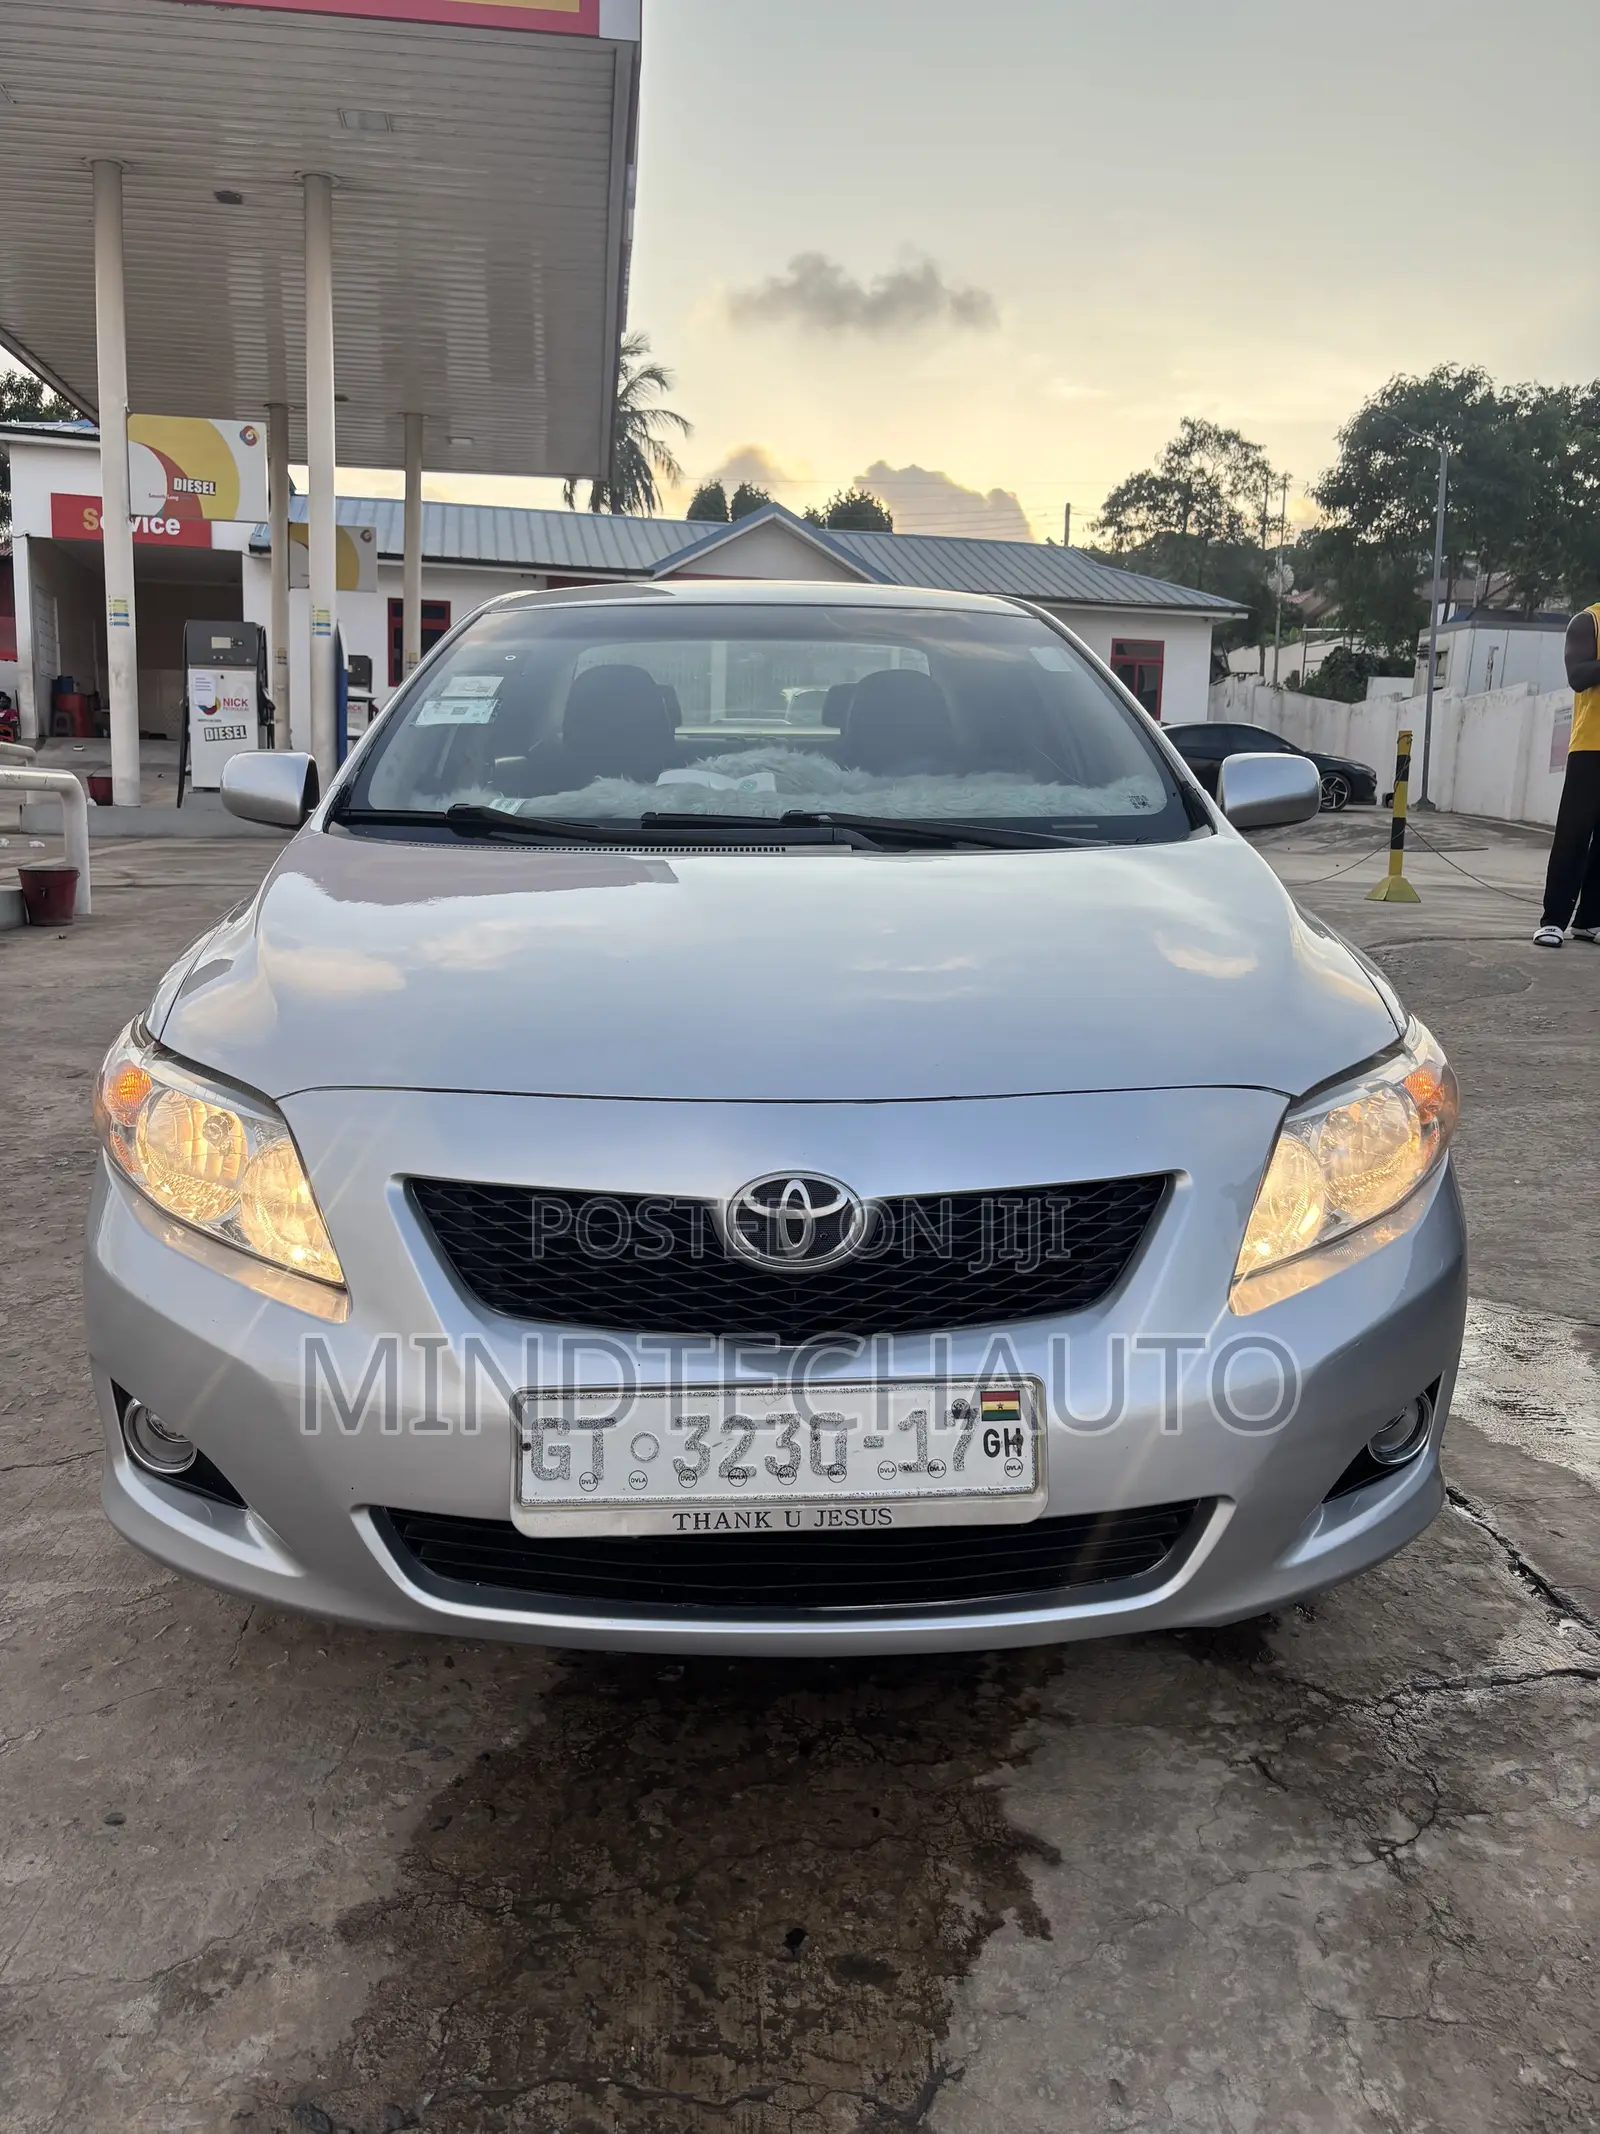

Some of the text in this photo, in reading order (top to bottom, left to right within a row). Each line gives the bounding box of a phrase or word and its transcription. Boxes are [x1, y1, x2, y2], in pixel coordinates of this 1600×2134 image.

[173, 477, 216, 495] DIESEL
[83, 507, 180, 536] Svice
[223, 698, 248, 707] NICK
[205, 727, 247, 740] DIESEL
[531, 1416, 617, 1480] GT
[983, 1428, 1023, 1458] GH
[929, 1465, 946, 1473] DVLA
[581, 1478, 597, 1486] DVLA
[672, 1508, 893, 1531] THANK U JESUS
